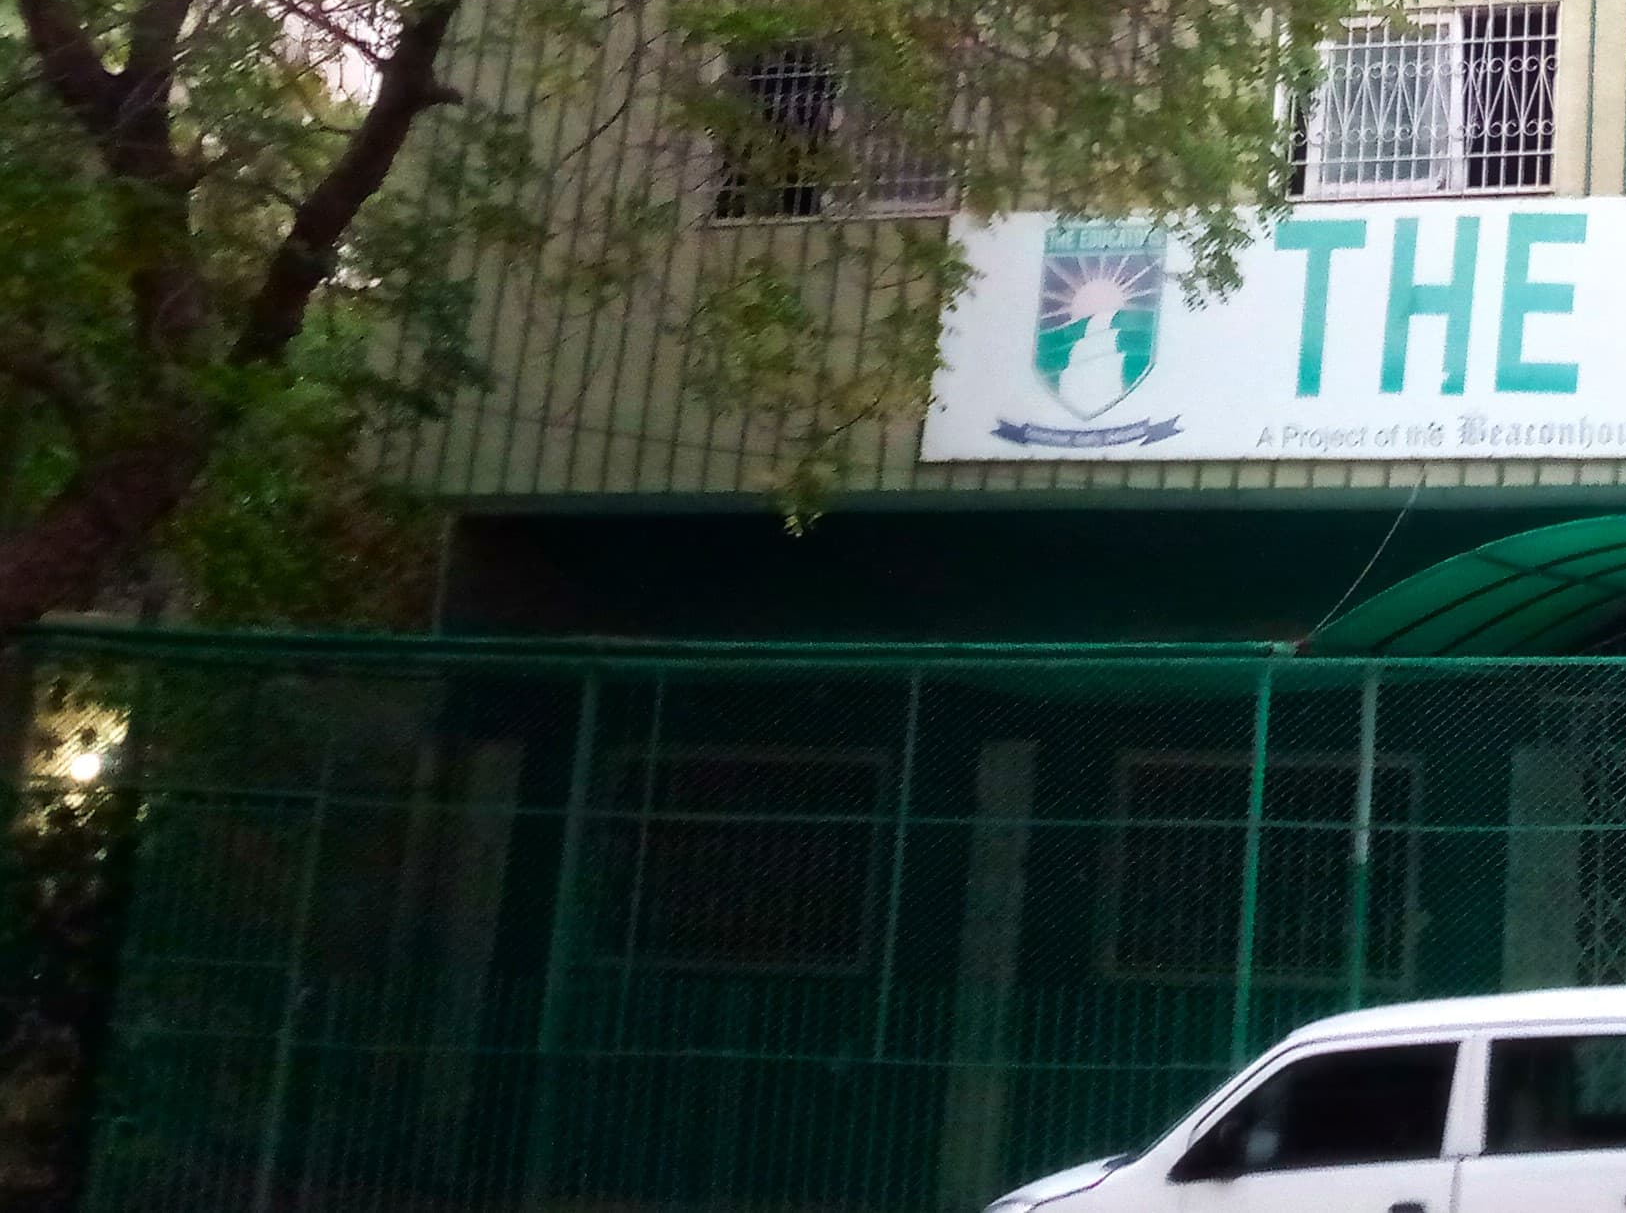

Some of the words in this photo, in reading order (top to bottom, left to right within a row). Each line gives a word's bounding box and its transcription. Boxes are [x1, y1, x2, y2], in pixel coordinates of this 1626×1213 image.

[1274, 212, 1588, 397] THE
[1256, 426, 1273, 448] A
[1282, 424, 1367, 453] Project
[1374, 423, 1400, 447] of
